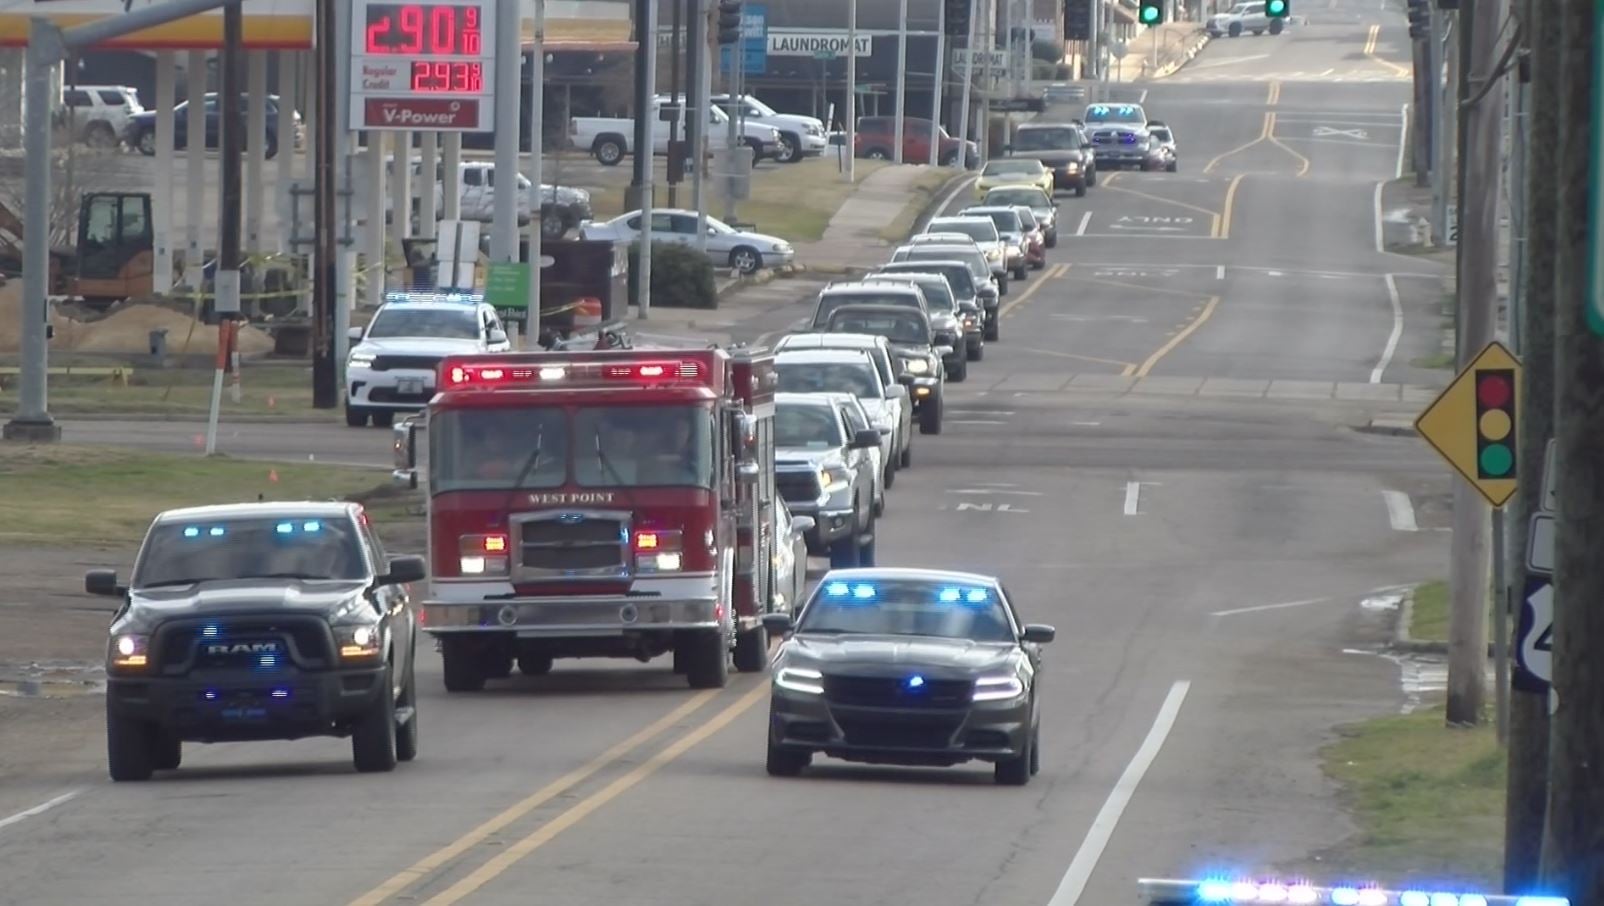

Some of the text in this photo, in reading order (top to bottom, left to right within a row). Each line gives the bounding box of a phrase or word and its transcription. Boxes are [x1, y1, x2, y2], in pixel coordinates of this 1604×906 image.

[772, 37, 869, 52] LAUNDROMAT
[362, 65, 397, 78] Regular
[362, 79, 390, 90] Credit
[384, 108, 457, 124] V-Power
[530, 491, 615, 504] WEST POINT
[207, 643, 277, 654] RAM
